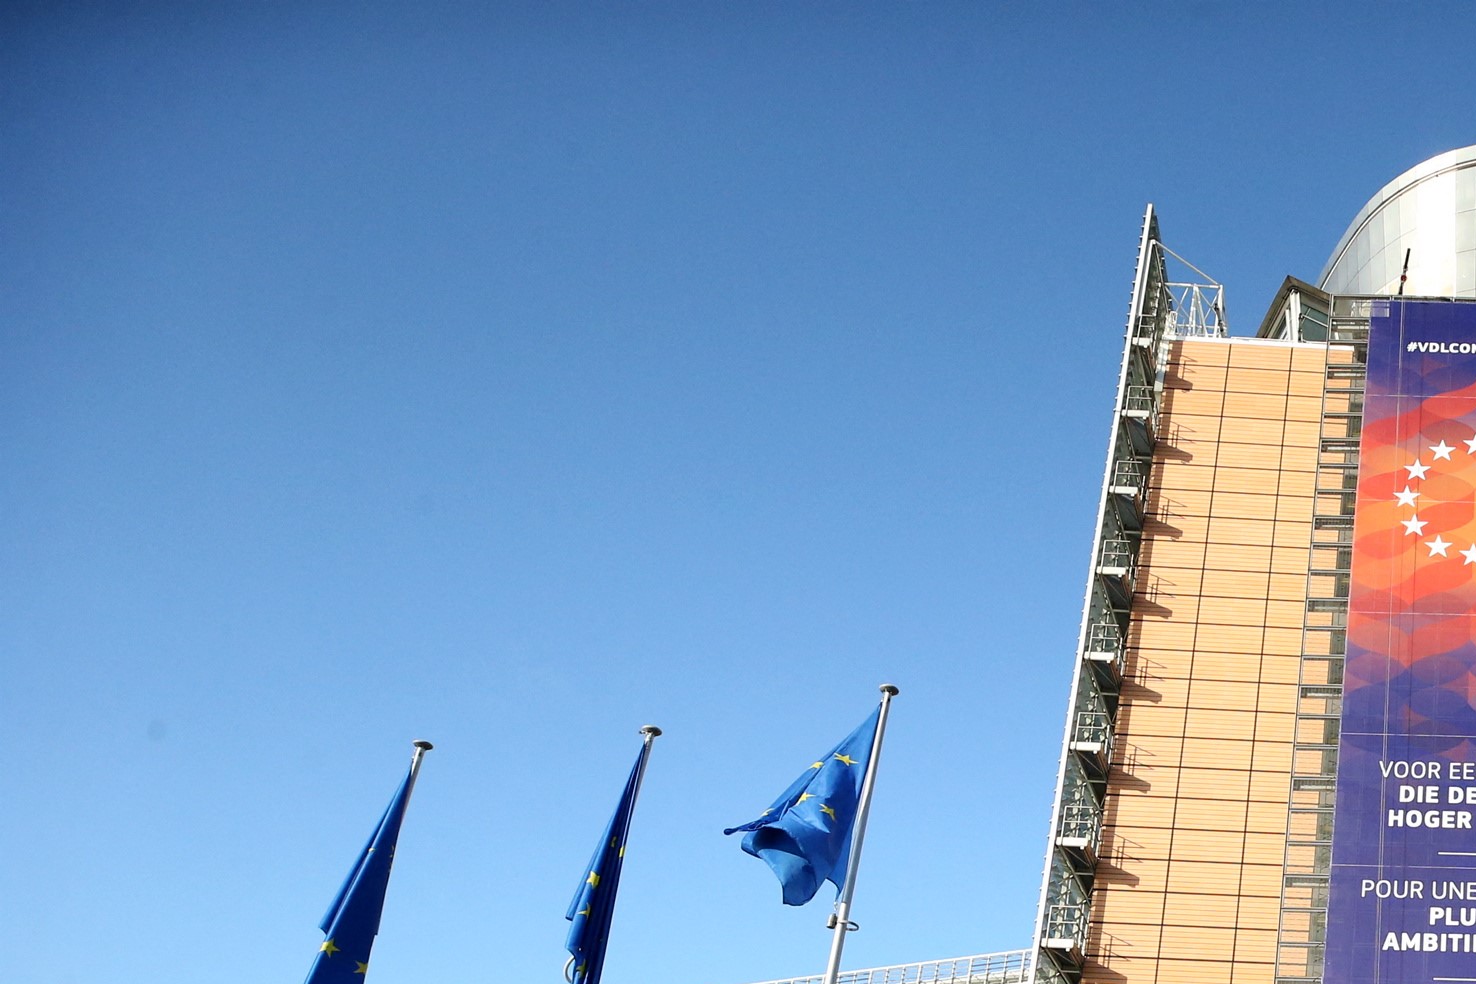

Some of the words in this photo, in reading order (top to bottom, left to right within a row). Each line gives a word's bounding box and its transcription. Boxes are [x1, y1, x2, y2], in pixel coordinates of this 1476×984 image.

[1379, 760, 1441, 780] VOOR
[1399, 785, 1439, 803] DIE
[1387, 809, 1472, 829] HOGER
[1361, 879, 1424, 899] POUR
